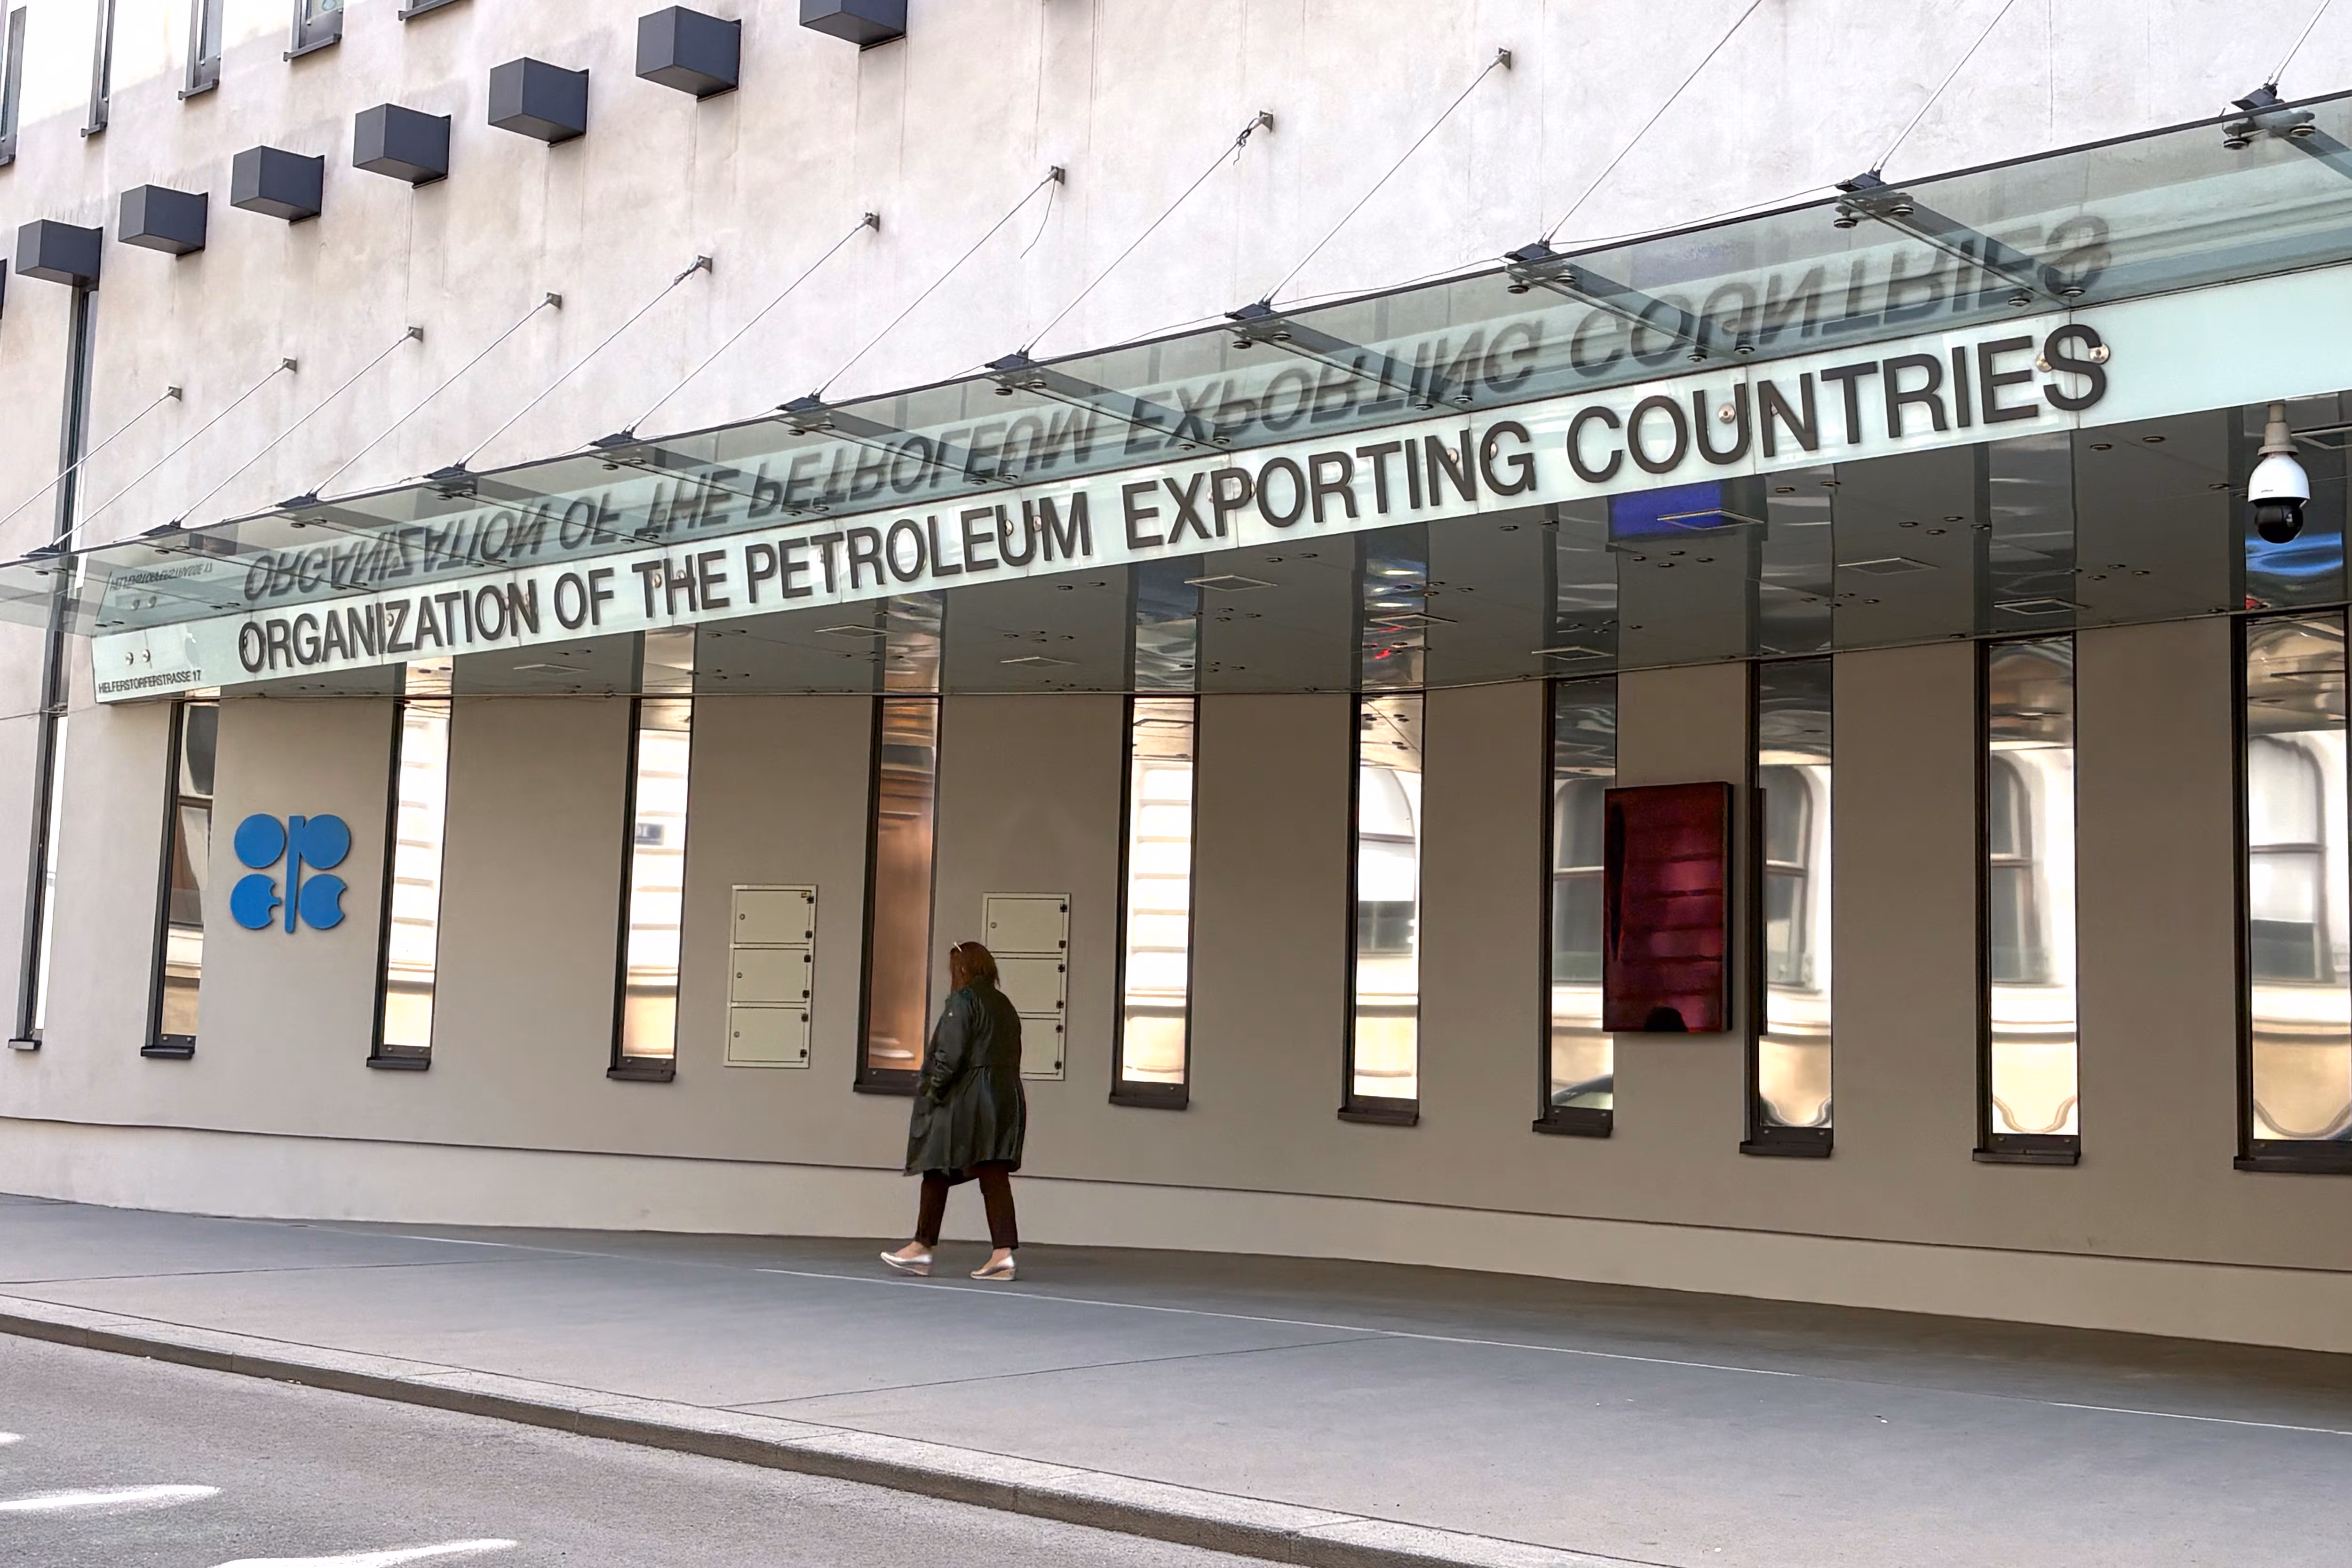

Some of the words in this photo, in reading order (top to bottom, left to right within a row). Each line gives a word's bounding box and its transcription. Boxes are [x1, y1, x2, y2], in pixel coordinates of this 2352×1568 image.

[238, 579, 540, 673] ORGANIZATION
[554, 567, 614, 630] OF
[632, 549, 730, 618] THE
[745, 491, 1093, 603] PETROLEUM
[1122, 421, 1537, 550] EXPORTING
[1566, 324, 2107, 483] COUNTRIES
[193, 670, 201, 681] 17
